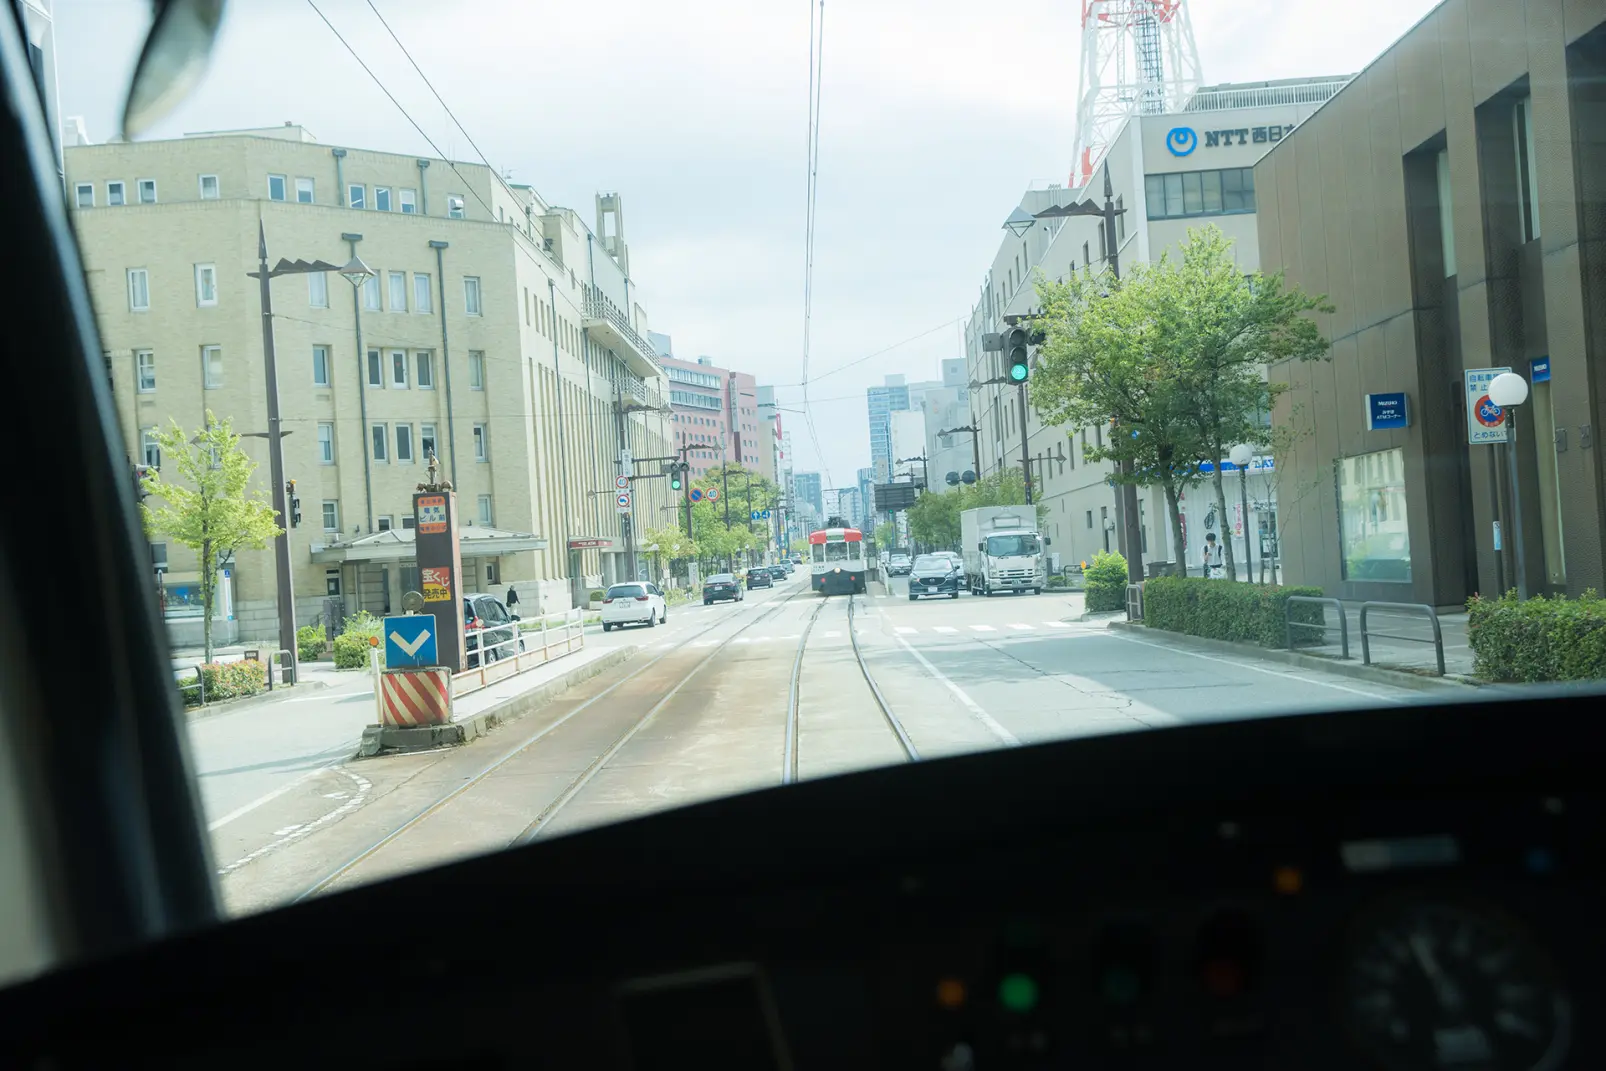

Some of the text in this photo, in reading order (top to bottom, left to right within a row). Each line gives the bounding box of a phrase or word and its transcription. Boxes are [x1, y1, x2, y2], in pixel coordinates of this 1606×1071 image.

[618, 478, 626, 486] 40
[708, 490, 717, 498] 40
[422, 569, 450, 587] 宝くじ
[423, 588, 448, 600] 発売中
